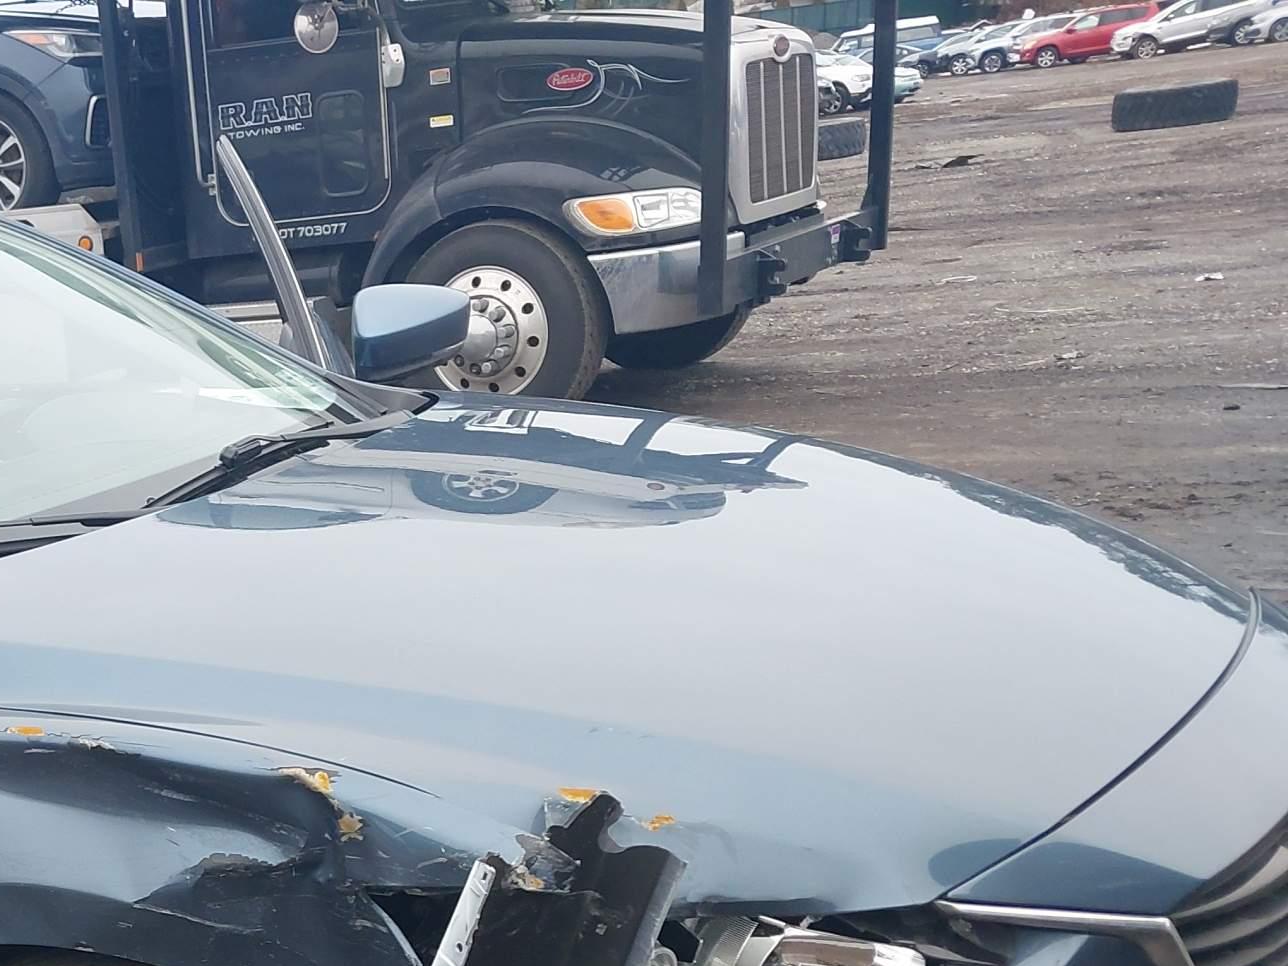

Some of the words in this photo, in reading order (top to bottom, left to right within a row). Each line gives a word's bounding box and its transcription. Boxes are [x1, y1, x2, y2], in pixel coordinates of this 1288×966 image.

[227, 125, 282, 140] TOWING
[284, 122, 305, 132] INC.
[278, 227, 295, 239] OT
[296, 222, 347, 238] 703077
